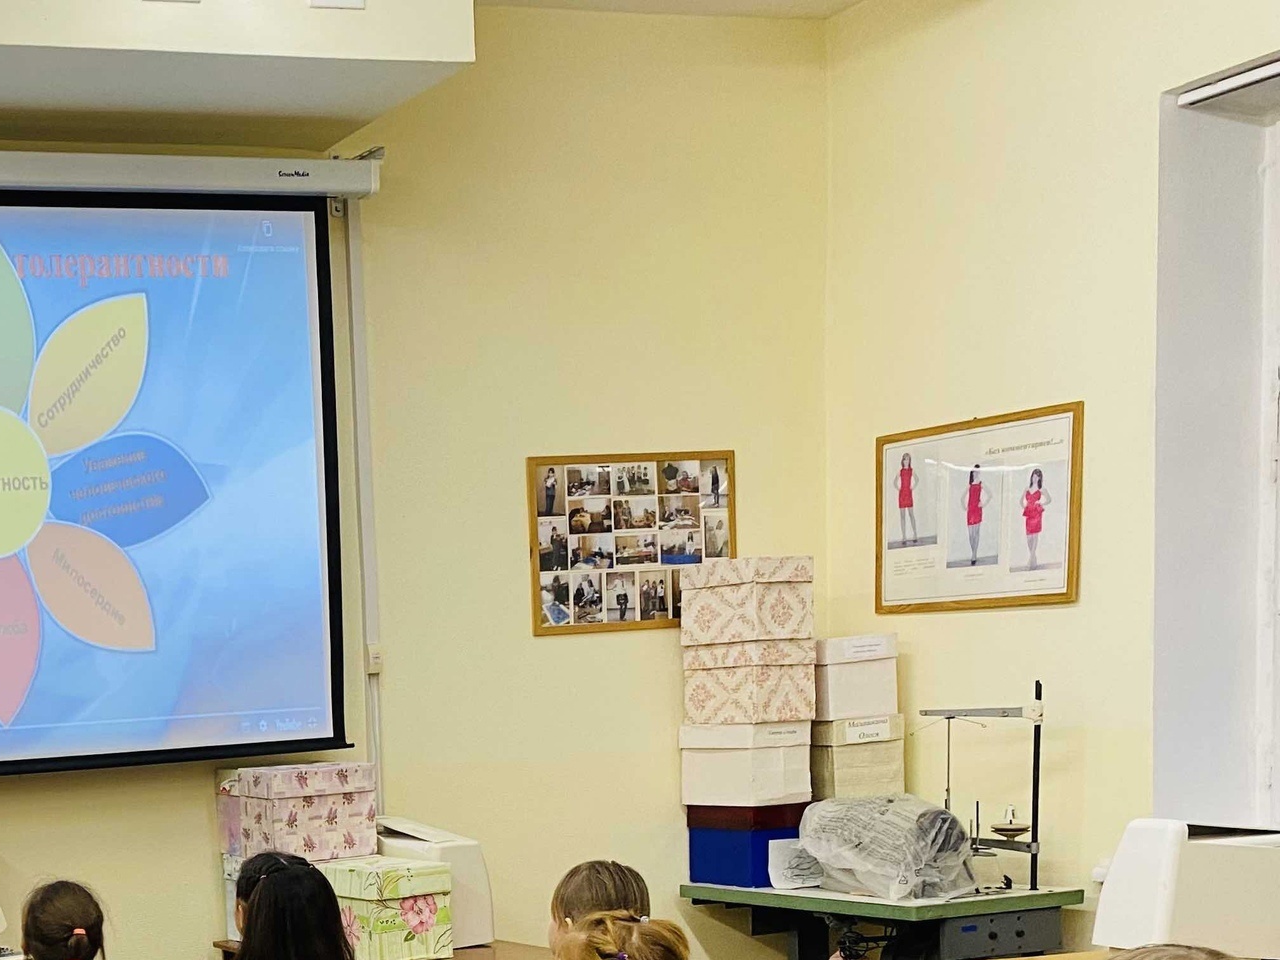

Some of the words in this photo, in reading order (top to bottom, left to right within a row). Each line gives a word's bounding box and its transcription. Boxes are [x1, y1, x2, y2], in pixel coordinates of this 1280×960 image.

[14, 252, 230, 288] толерантности
[37, 326, 126, 428] Сотрудничество
[52, 548, 126, 626] Милосердие
